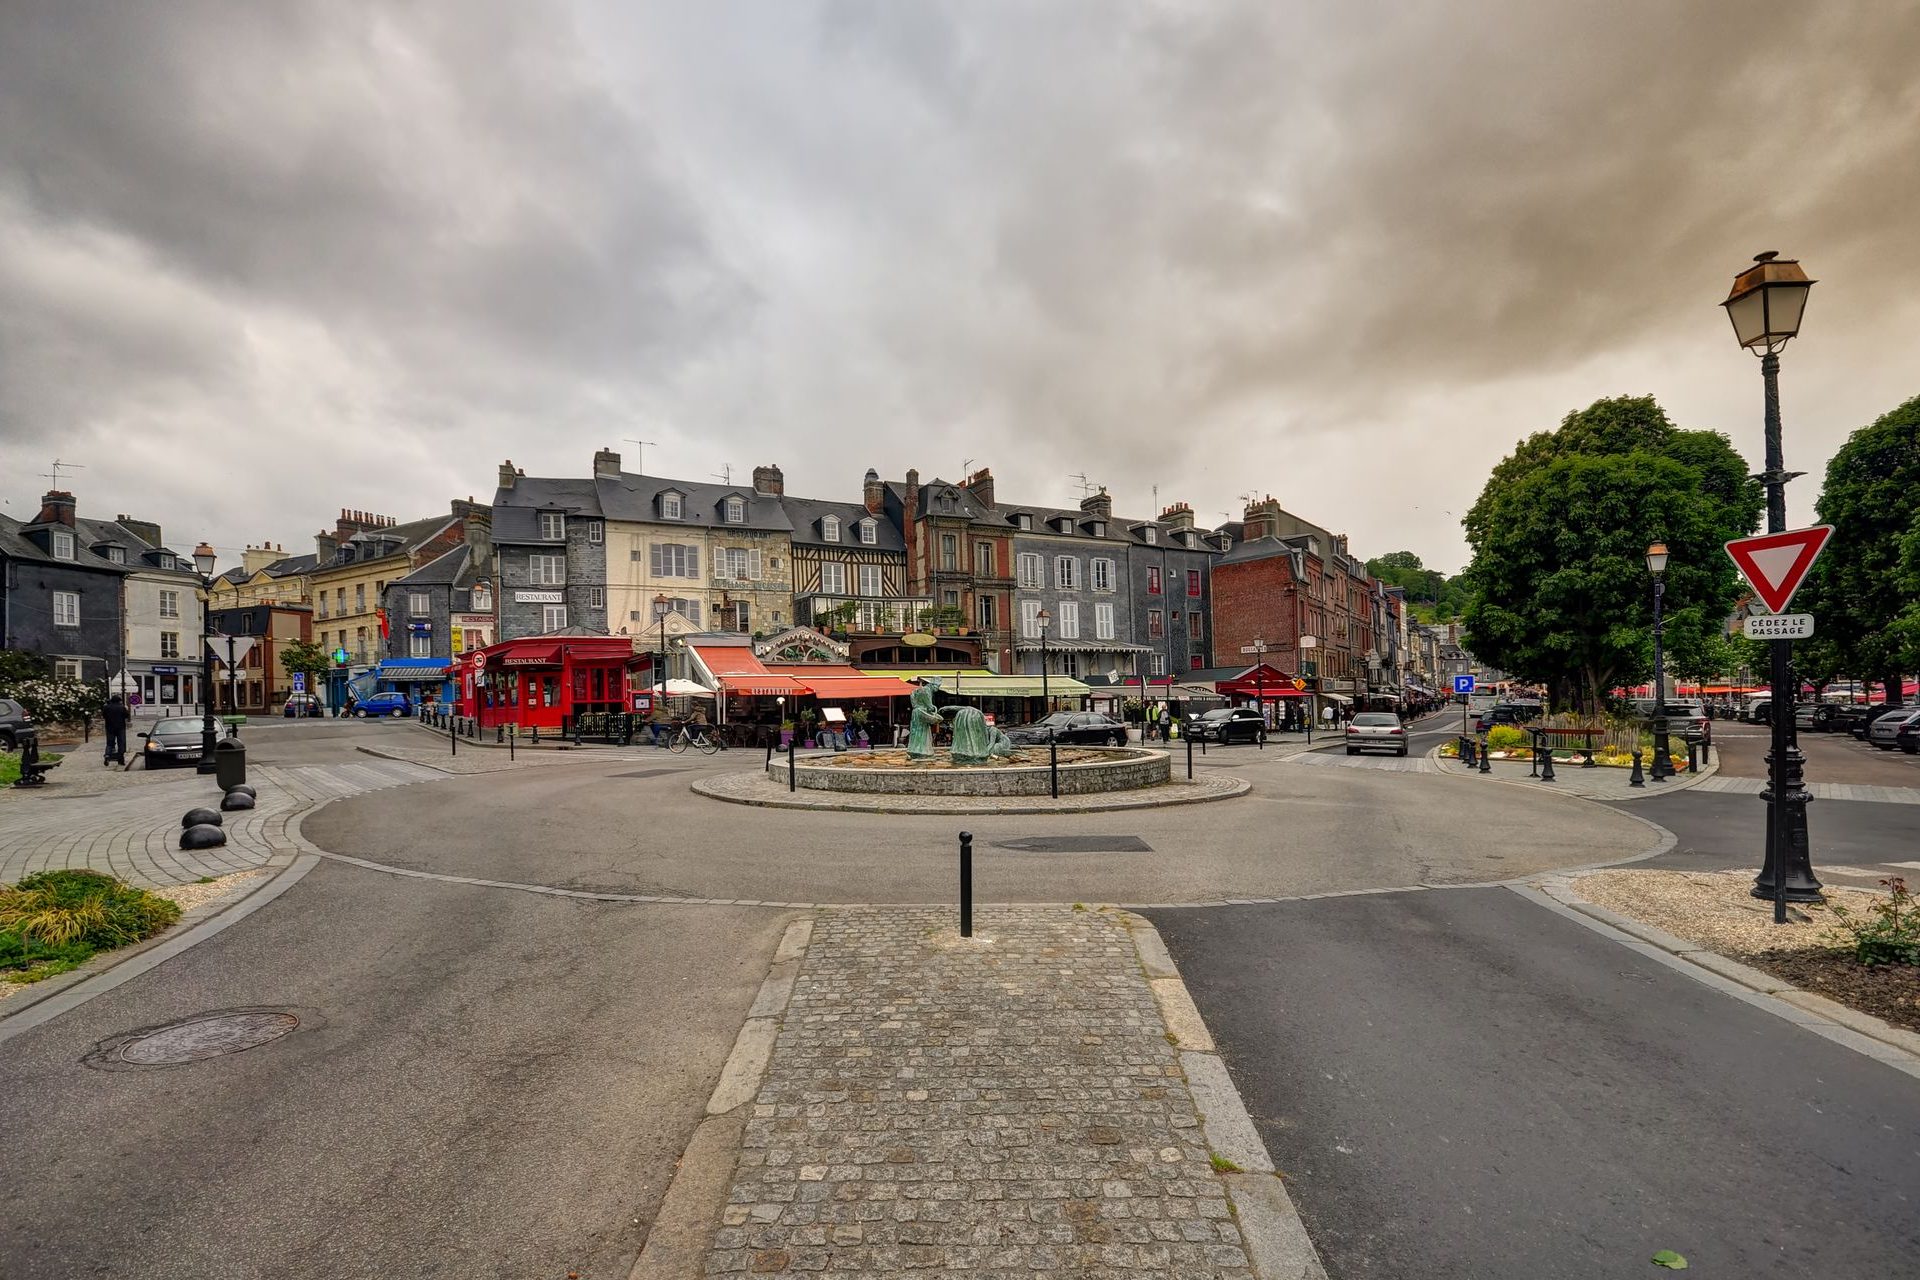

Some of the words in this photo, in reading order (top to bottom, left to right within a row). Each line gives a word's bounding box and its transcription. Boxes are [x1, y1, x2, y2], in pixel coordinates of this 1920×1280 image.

[727, 529, 771, 539] RESTAURANT
[516, 593, 562, 601] RESTAURANT
[1751, 618, 1788, 627] CÉDEZ
[1792, 618, 1806, 626] LE
[1752, 626, 1804, 635] PASSAGE
[1459, 678, 1470, 690] P
